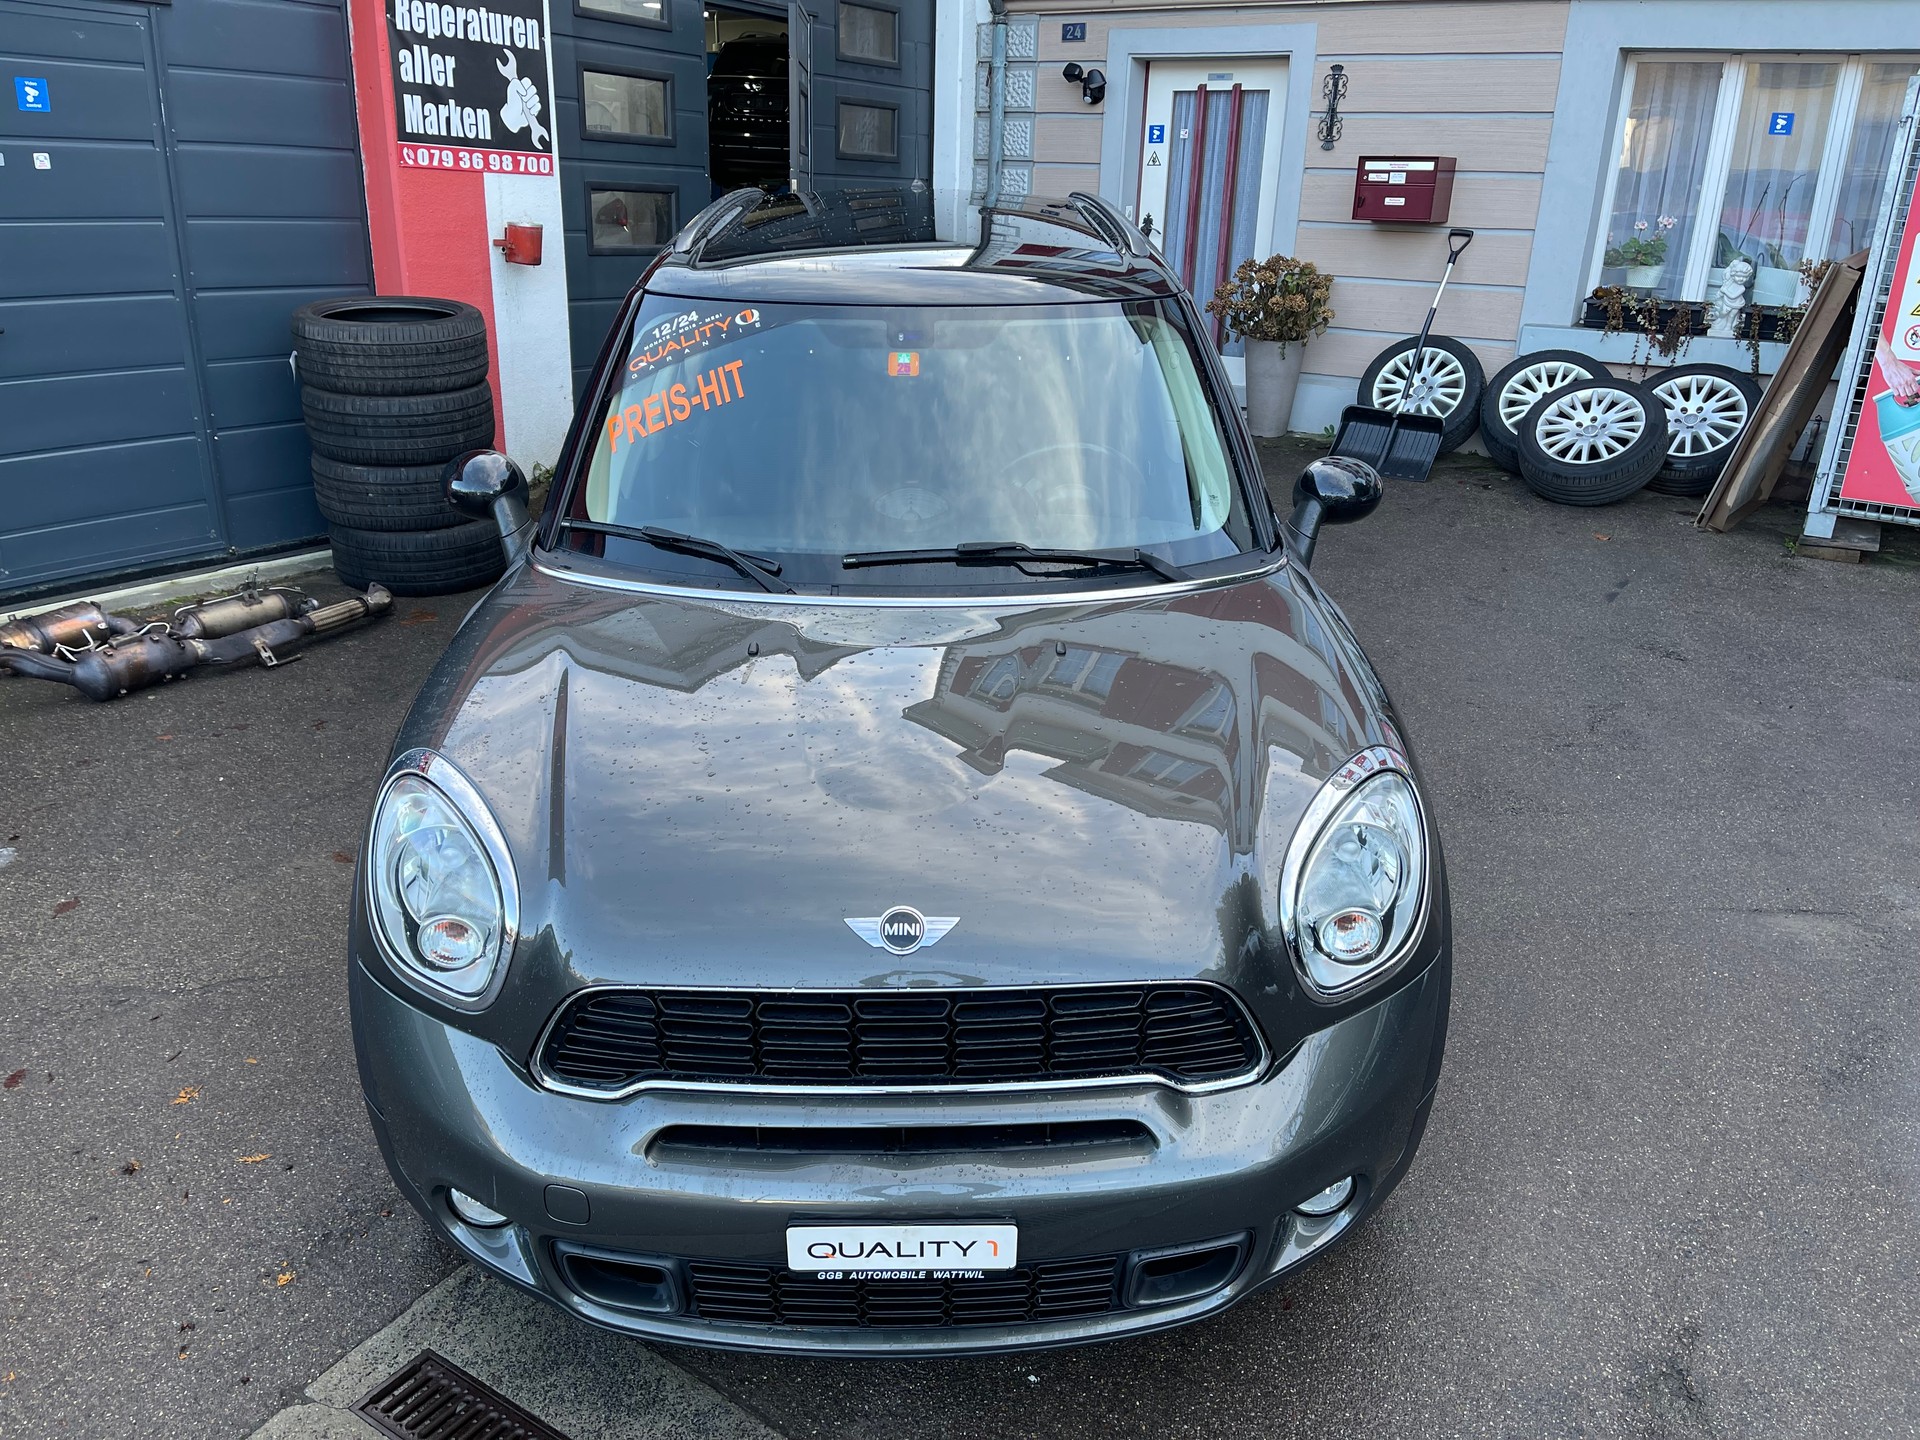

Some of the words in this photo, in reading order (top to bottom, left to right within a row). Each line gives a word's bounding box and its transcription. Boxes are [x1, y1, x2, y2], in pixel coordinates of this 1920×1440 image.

[395, 0, 540, 50] Reperaturen
[1066, 25, 1082, 39] 24
[399, 44, 456, 87] aller
[403, 94, 491, 140] Marken
[417, 148, 454, 167] 079
[458, 151, 484, 170] 36
[489, 154, 513, 172] 98
[517, 156, 550, 175] 700
[652, 310, 699, 338] 12/24
[629, 316, 732, 372] QUALITY
[607, 359, 745, 453] PREIS-HIT
[884, 922, 920, 936] MINI
[807, 1240, 979, 1259] QUALITY
[986, 1240, 998, 1257] 1
[817, 1271, 843, 1280] GGB
[849, 1271, 927, 1280] AUTOMOBILE
[933, 1270, 985, 1279] WATTWIL
